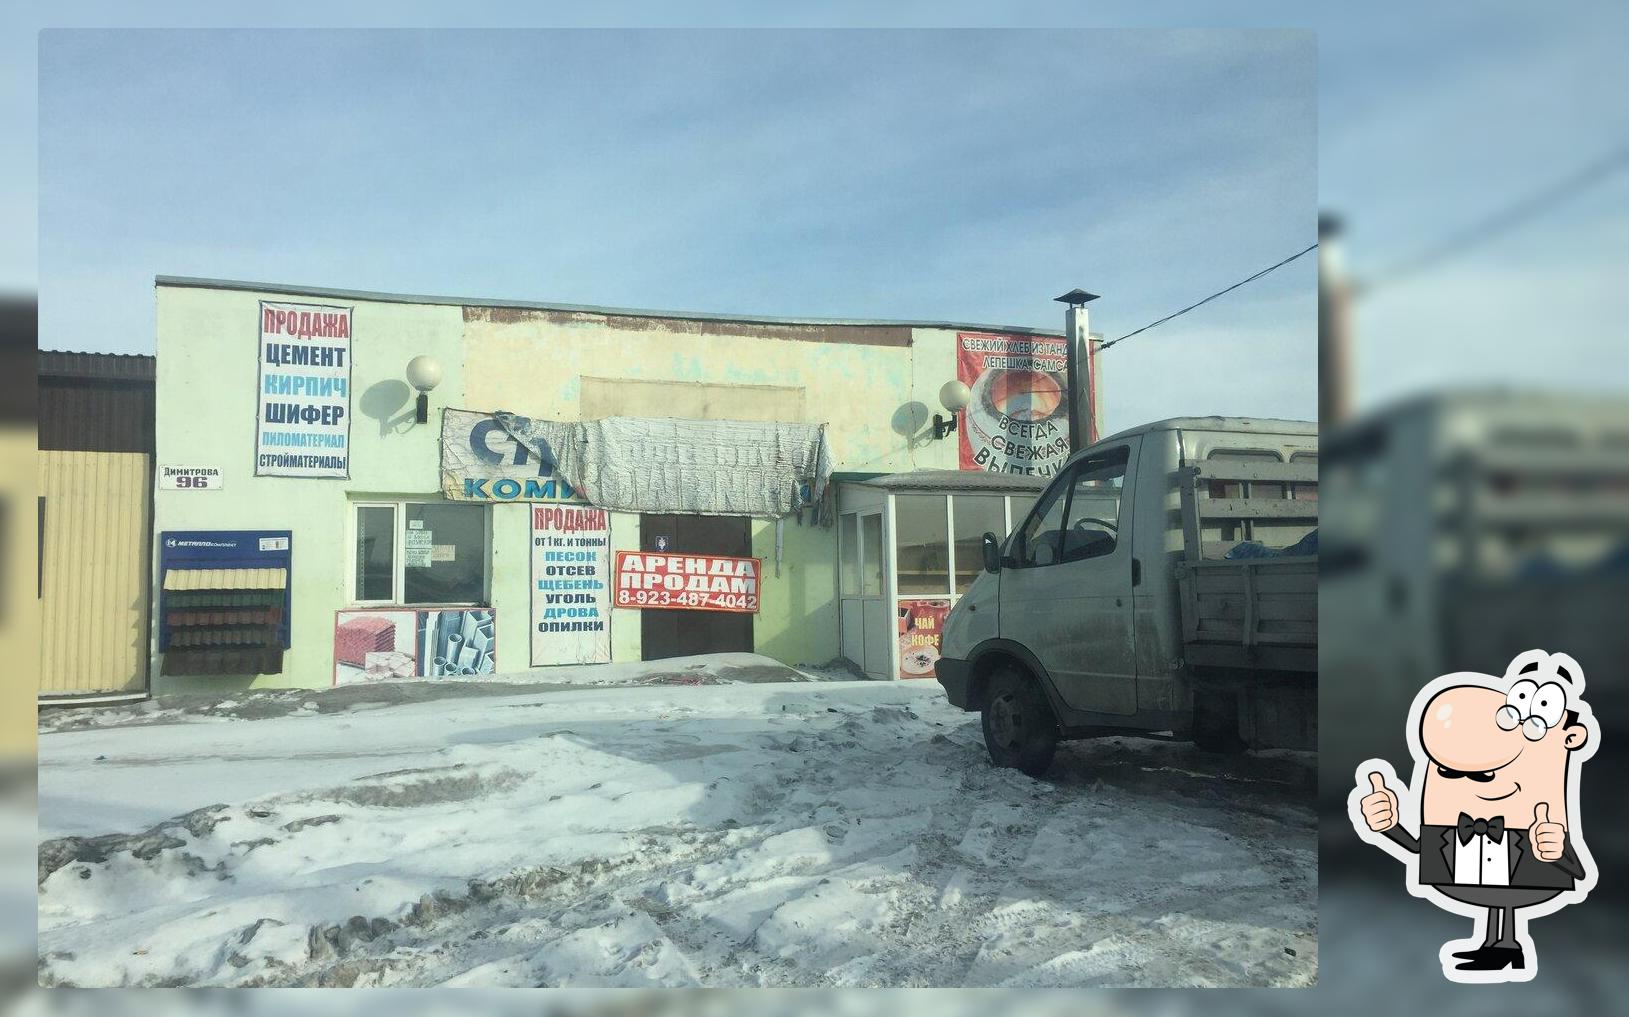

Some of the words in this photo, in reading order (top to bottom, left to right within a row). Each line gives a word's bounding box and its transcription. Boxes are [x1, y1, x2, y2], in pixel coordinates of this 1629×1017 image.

[264, 308, 349, 340] ПРОДАЖА
[266, 343, 346, 367] ЦЕМЕНТ
[962, 337, 1005, 352] СВЕЖИЙ
[1006, 341, 1030, 354] ХЛЕБ
[1031, 343, 1044, 355] ИЗ
[264, 374, 347, 398] КИРПИЧ
[265, 403, 344, 425] ШИФЕР
[998, 415, 1058, 440] ВСЕГДА
[262, 431, 345, 449] ПИЛОМАТЕРИАЛ
[991, 435, 1069, 461] СВЕЖАЯ
[259, 452, 346, 470] СТРОЙМАТЕРИАЛЫ
[176, 476, 208, 488] 96
[534, 507, 607, 534] ПРОДАЖА
[547, 536, 552, 546] 1
[545, 551, 597, 562] ПЕСОК
[621, 554, 756, 577] АРЕНДА
[545, 566, 596, 576] ОТСЕВ
[538, 579, 604, 591] ЩЕБЕНЬ
[620, 572, 756, 594] ПРОДАМ
[545, 594, 596, 604] УГОЛЬ
[619, 589, 757, 609] 8-923-487-4042
[543, 607, 599, 619] ДРОВА
[914, 615, 935, 629] ЧАЙ
[538, 621, 604, 632] ОПИЛКИ
[911, 634, 939, 646] КОФЕ
